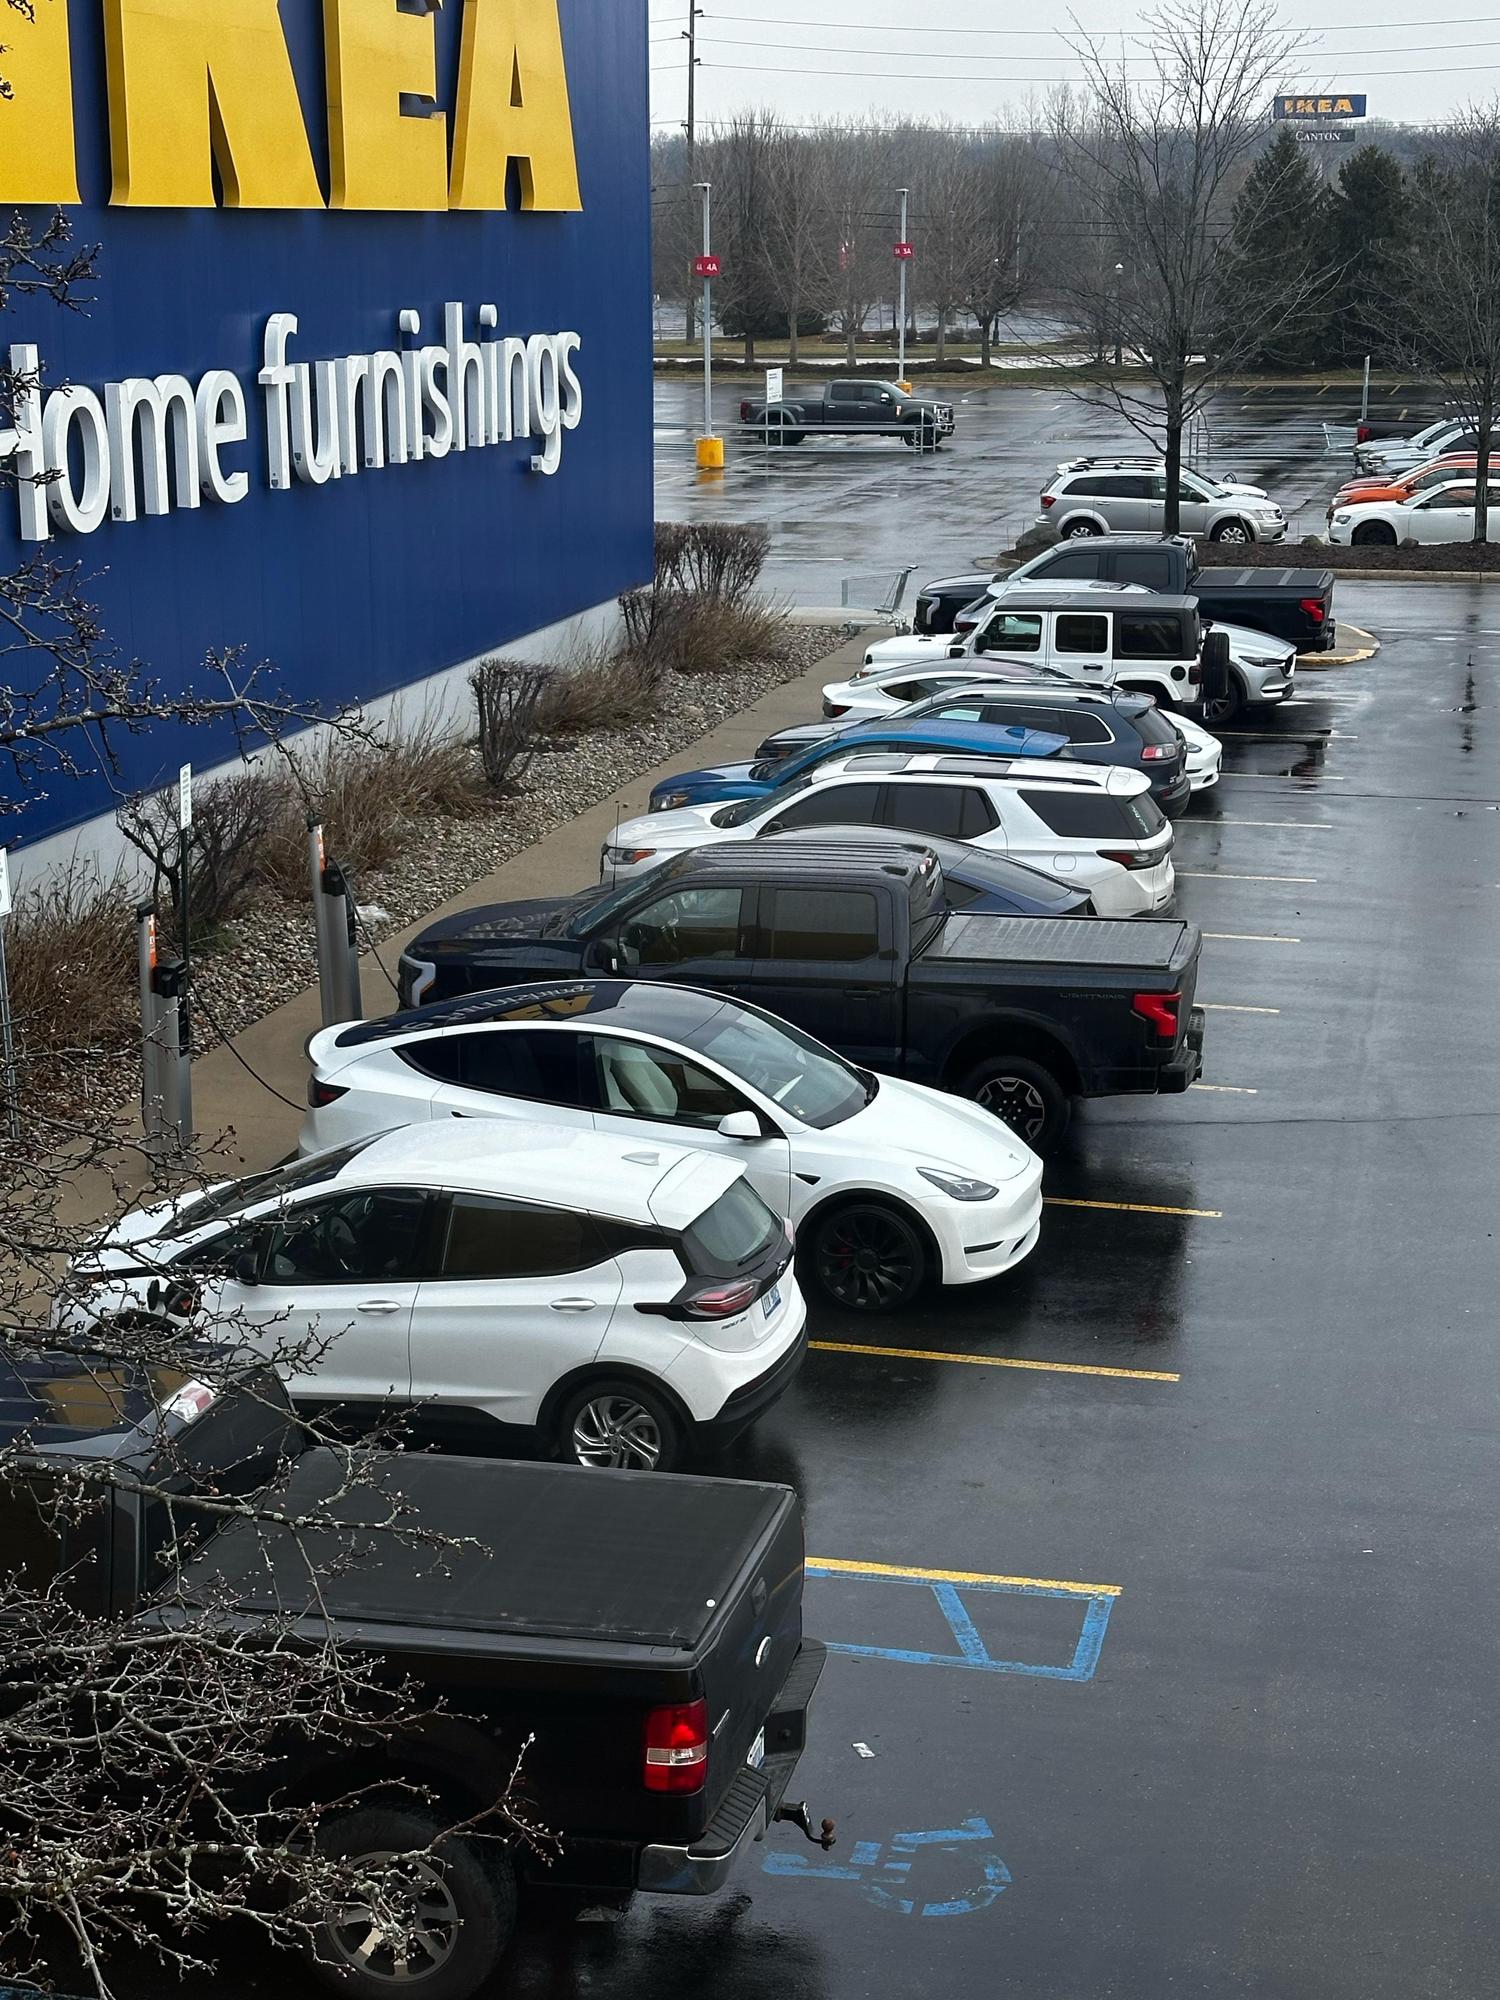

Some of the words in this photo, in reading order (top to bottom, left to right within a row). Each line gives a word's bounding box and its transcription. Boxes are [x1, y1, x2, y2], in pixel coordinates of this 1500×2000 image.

[1285, 99, 1353, 113] IKEA
[706, 263, 718, 271] 4A
[258, 302, 583, 490] furnishings
